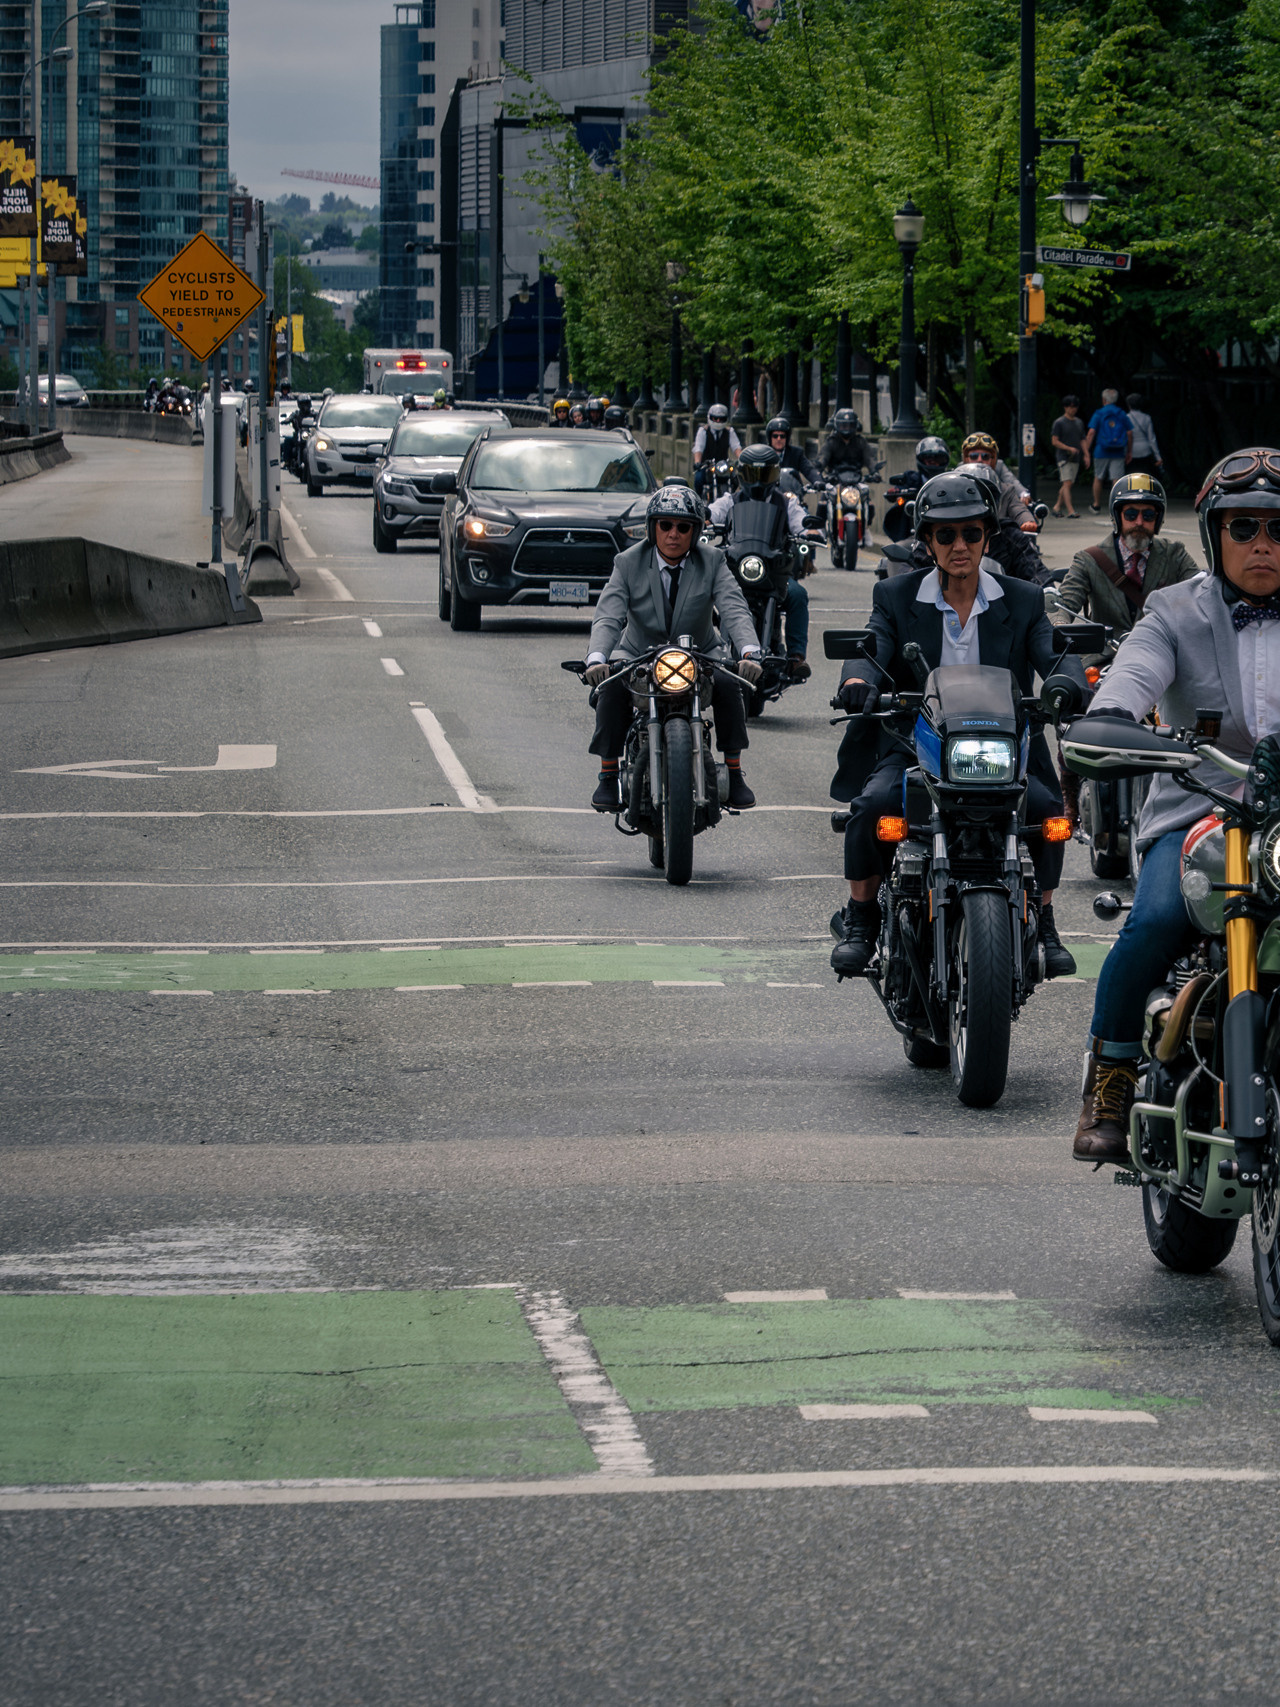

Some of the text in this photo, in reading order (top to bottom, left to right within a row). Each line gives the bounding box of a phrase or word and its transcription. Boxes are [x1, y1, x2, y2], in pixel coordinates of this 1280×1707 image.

[1043, 249, 1074, 262] Citadel
[1076, 253, 1105, 265] Parade
[168, 272, 236, 284] CYCLISTS
[169, 290, 234, 301] YIELD TO
[162, 307, 241, 317] PEDESTRIANS
